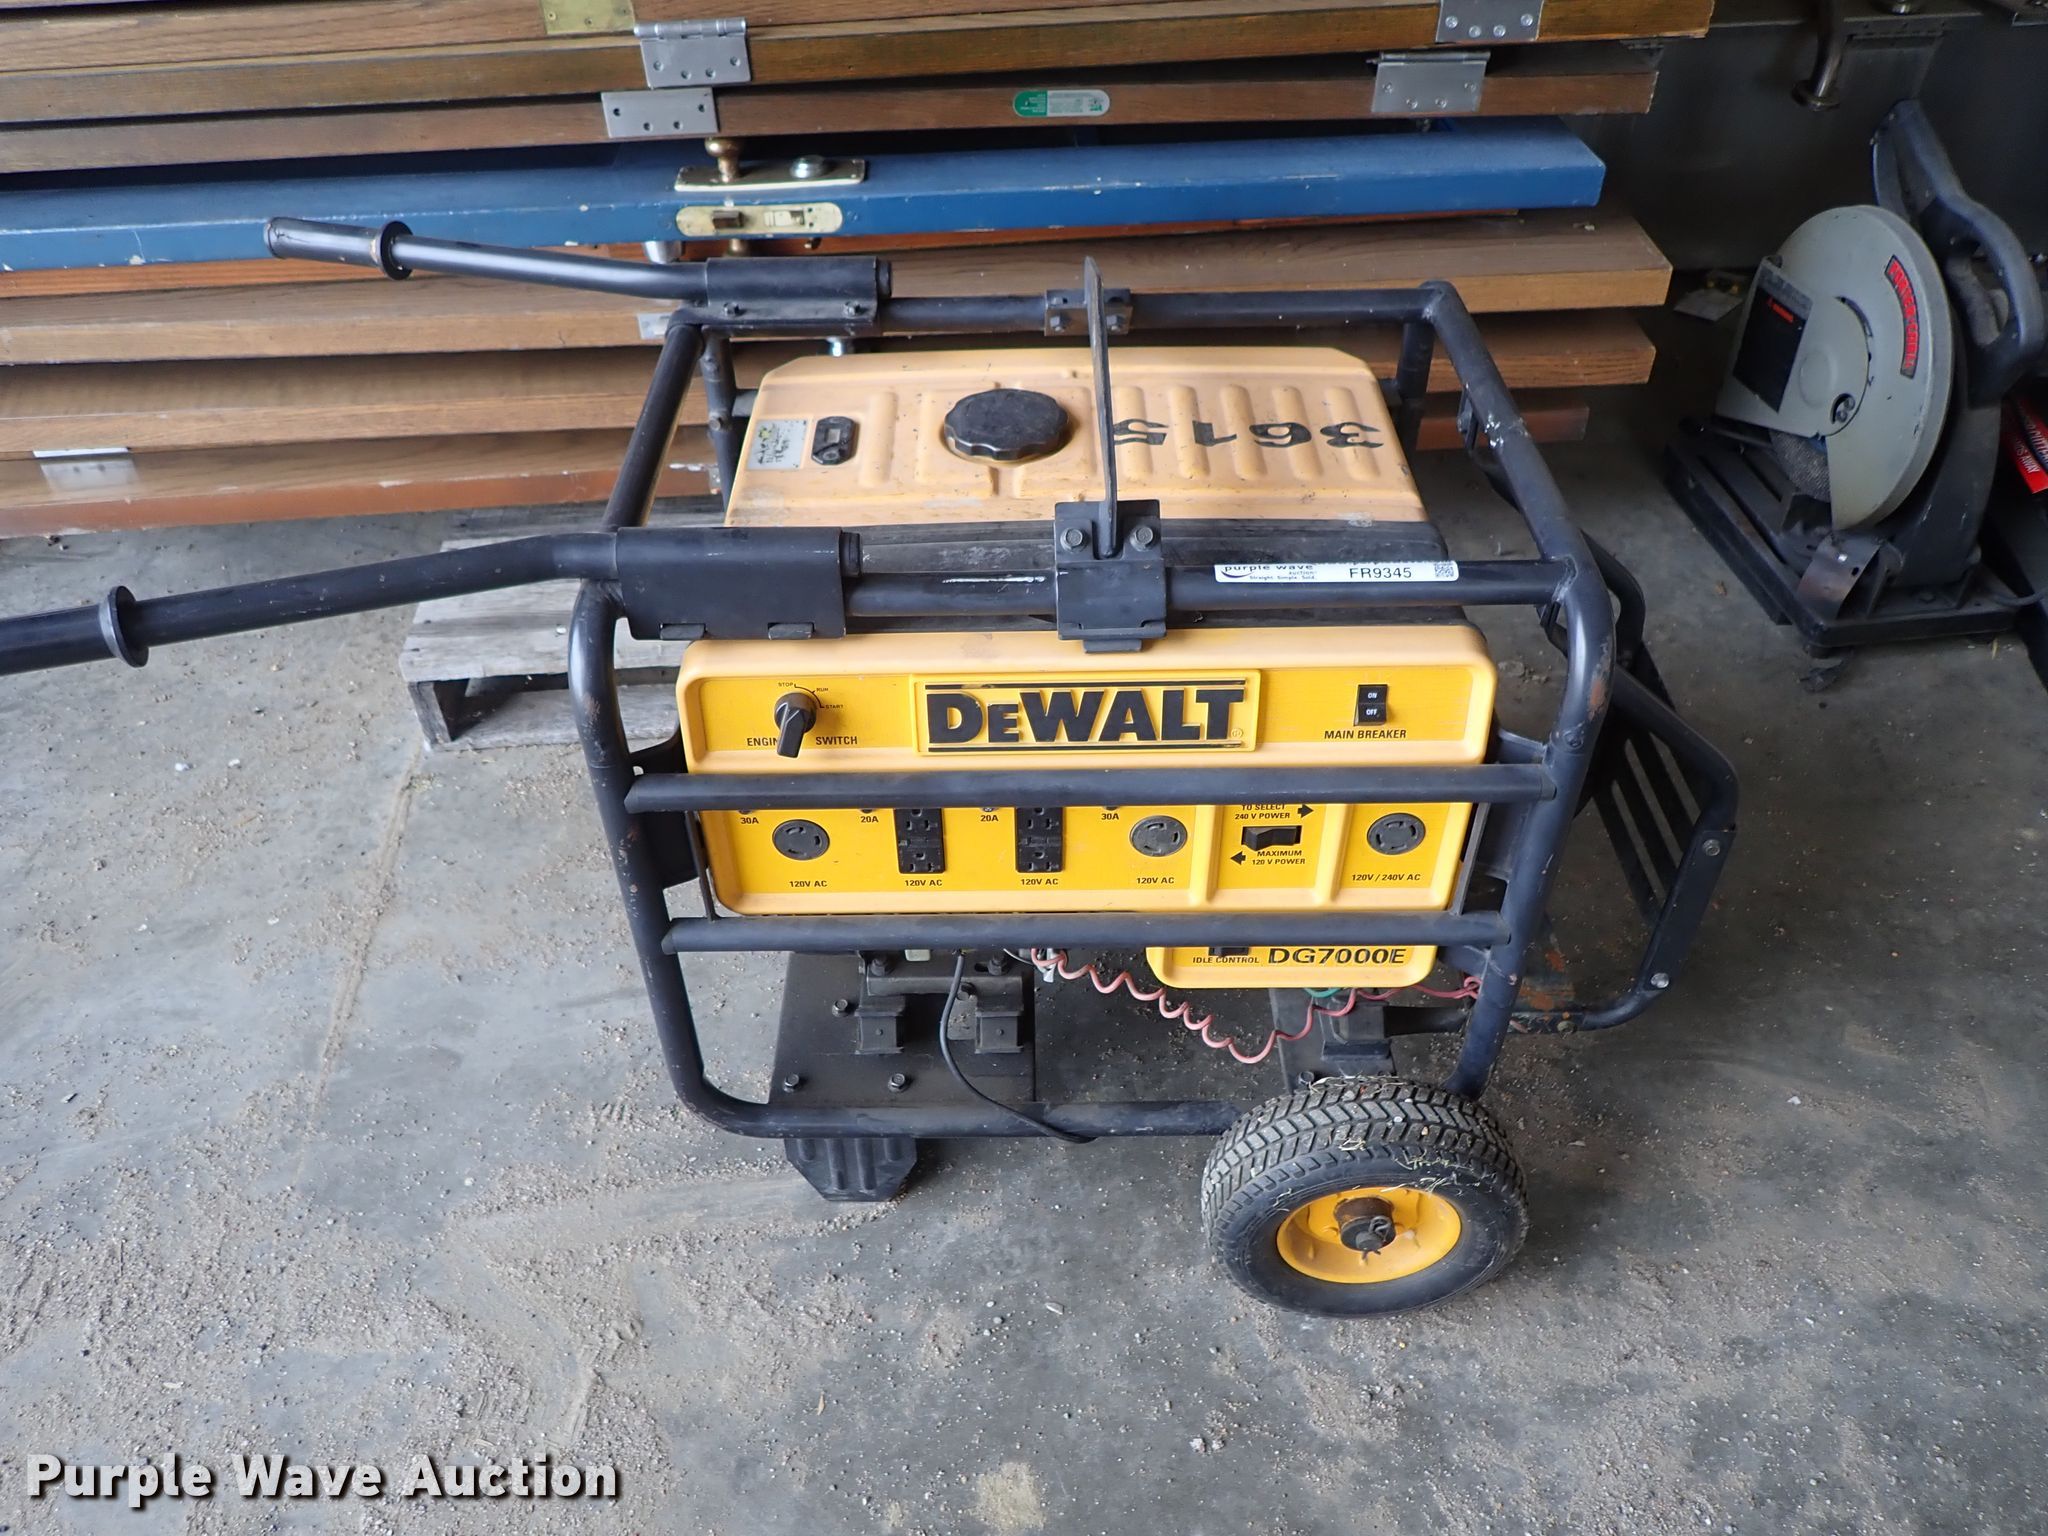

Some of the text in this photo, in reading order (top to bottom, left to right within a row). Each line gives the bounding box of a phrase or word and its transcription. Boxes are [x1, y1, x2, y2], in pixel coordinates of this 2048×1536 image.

[1112, 418, 1384, 448] 3615
[1349, 567, 1412, 579] FR9345
[927, 690, 1244, 743] DEWALT
[1324, 729, 1407, 739] MAIN BREAKER
[815, 736, 858, 745] SWITCH
[860, 815, 879, 823] 20A
[980, 814, 999, 822] 20A
[1101, 812, 1119, 820] 30A
[740, 817, 759, 825] 30A
[1044, 878, 1059, 886] AC
[1136, 876, 1175, 885] 120V AC
[1351, 874, 1373, 882] 120V
[1382, 873, 1404, 881] 240V
[1407, 873, 1421, 881] AC
[789, 880, 828, 888] 120V AC
[904, 879, 943, 888] 120V AC
[1215, 956, 1260, 964] CONTROL
[1268, 948, 1407, 965] DG7000E
